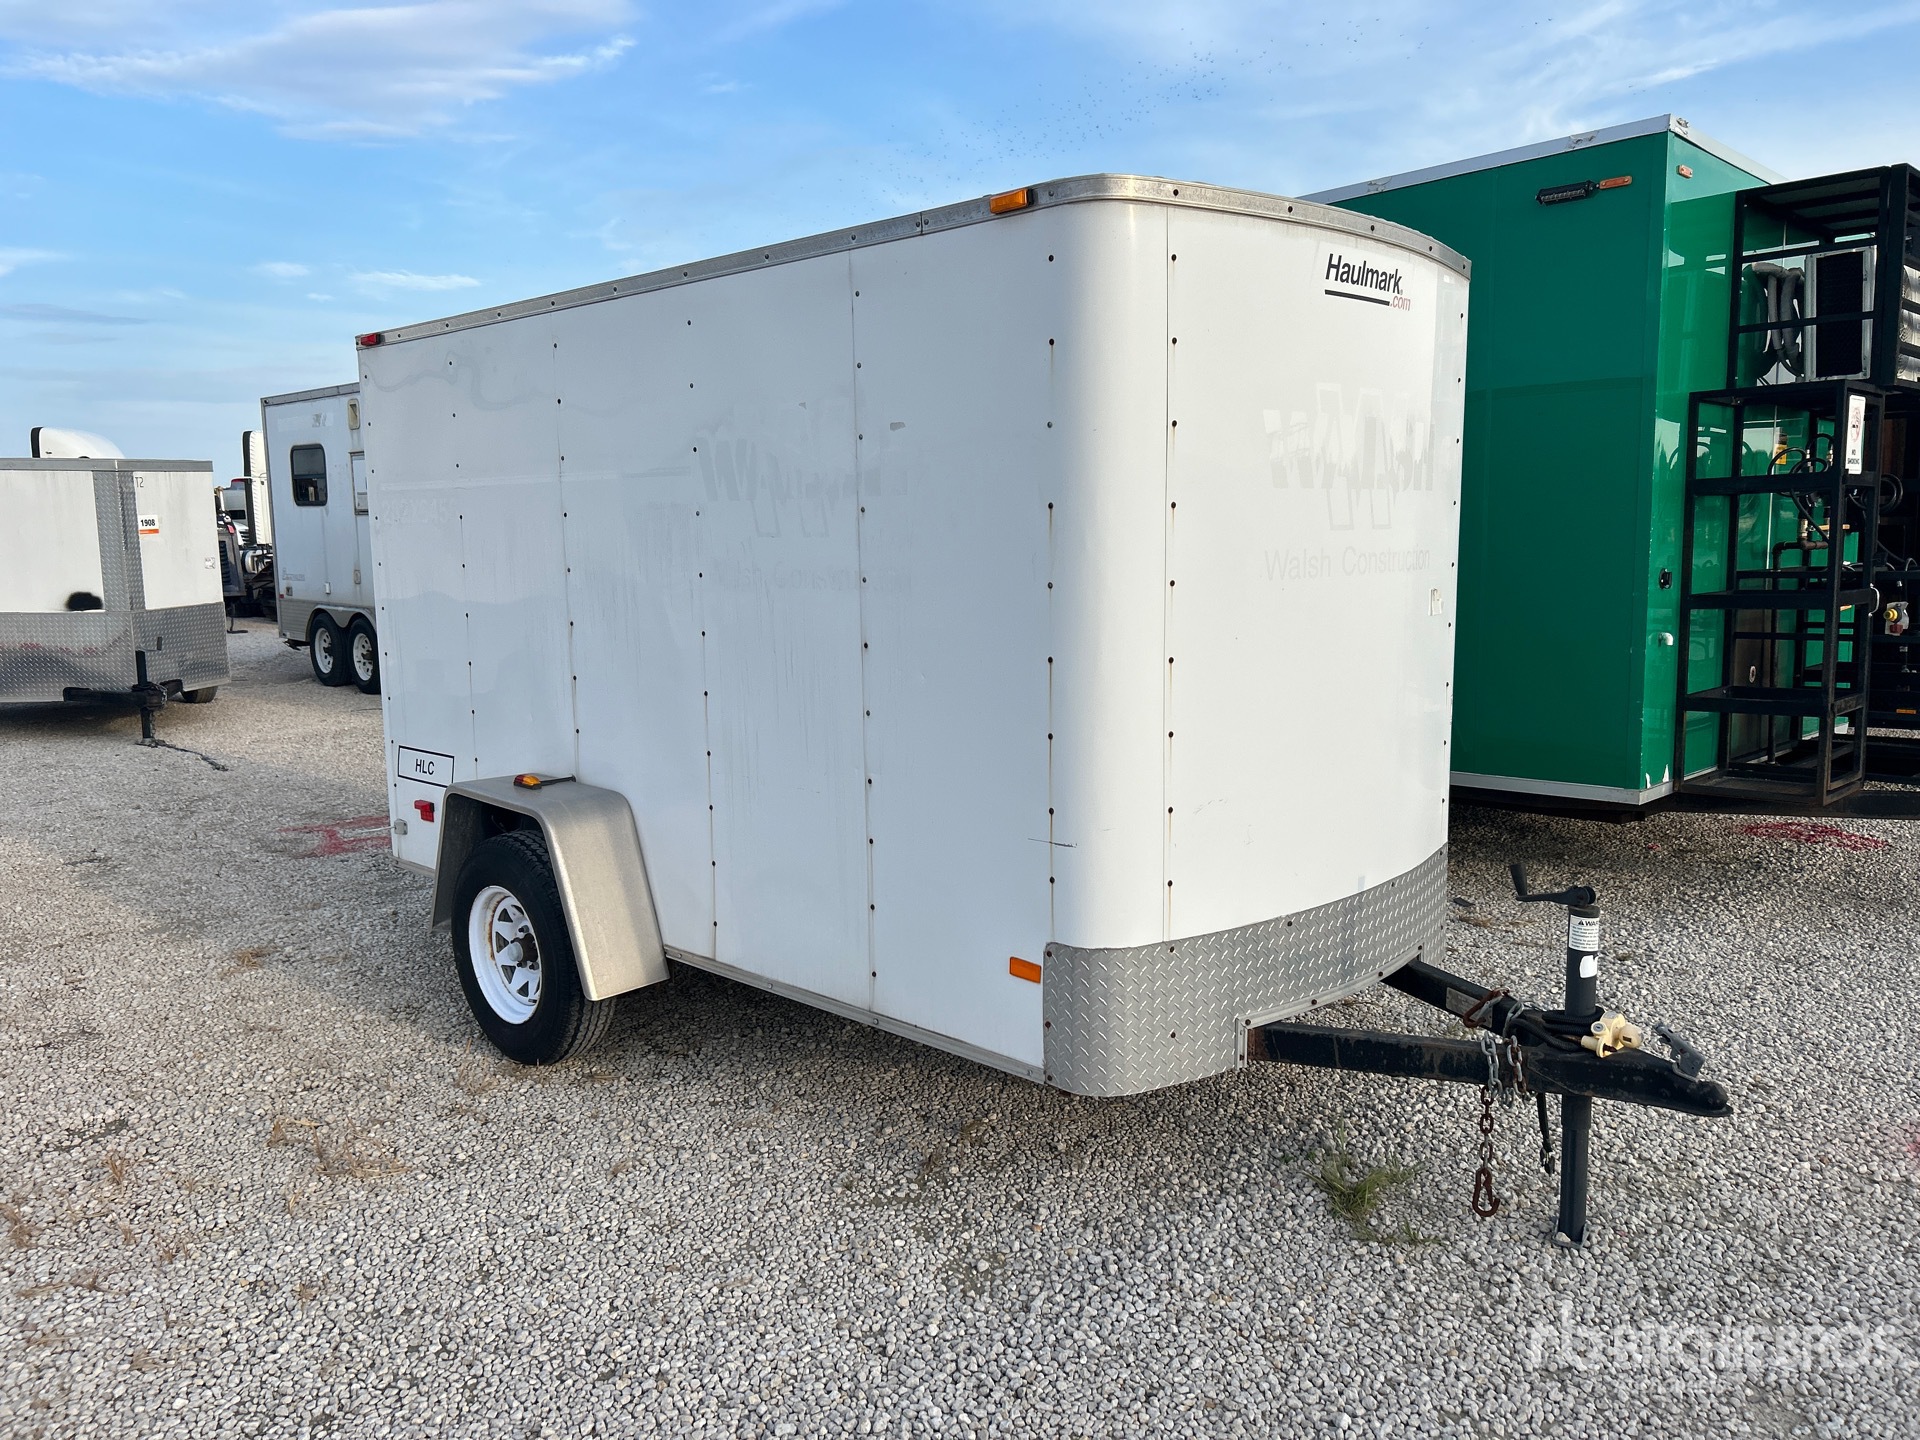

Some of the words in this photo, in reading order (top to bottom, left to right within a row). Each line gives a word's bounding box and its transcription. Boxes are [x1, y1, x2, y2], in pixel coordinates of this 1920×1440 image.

[1325, 253, 1402, 294] Haulmark
[1264, 547, 1331, 581] Walsh
[1342, 545, 1430, 577] Construction
[415, 758, 435, 775] HLC
